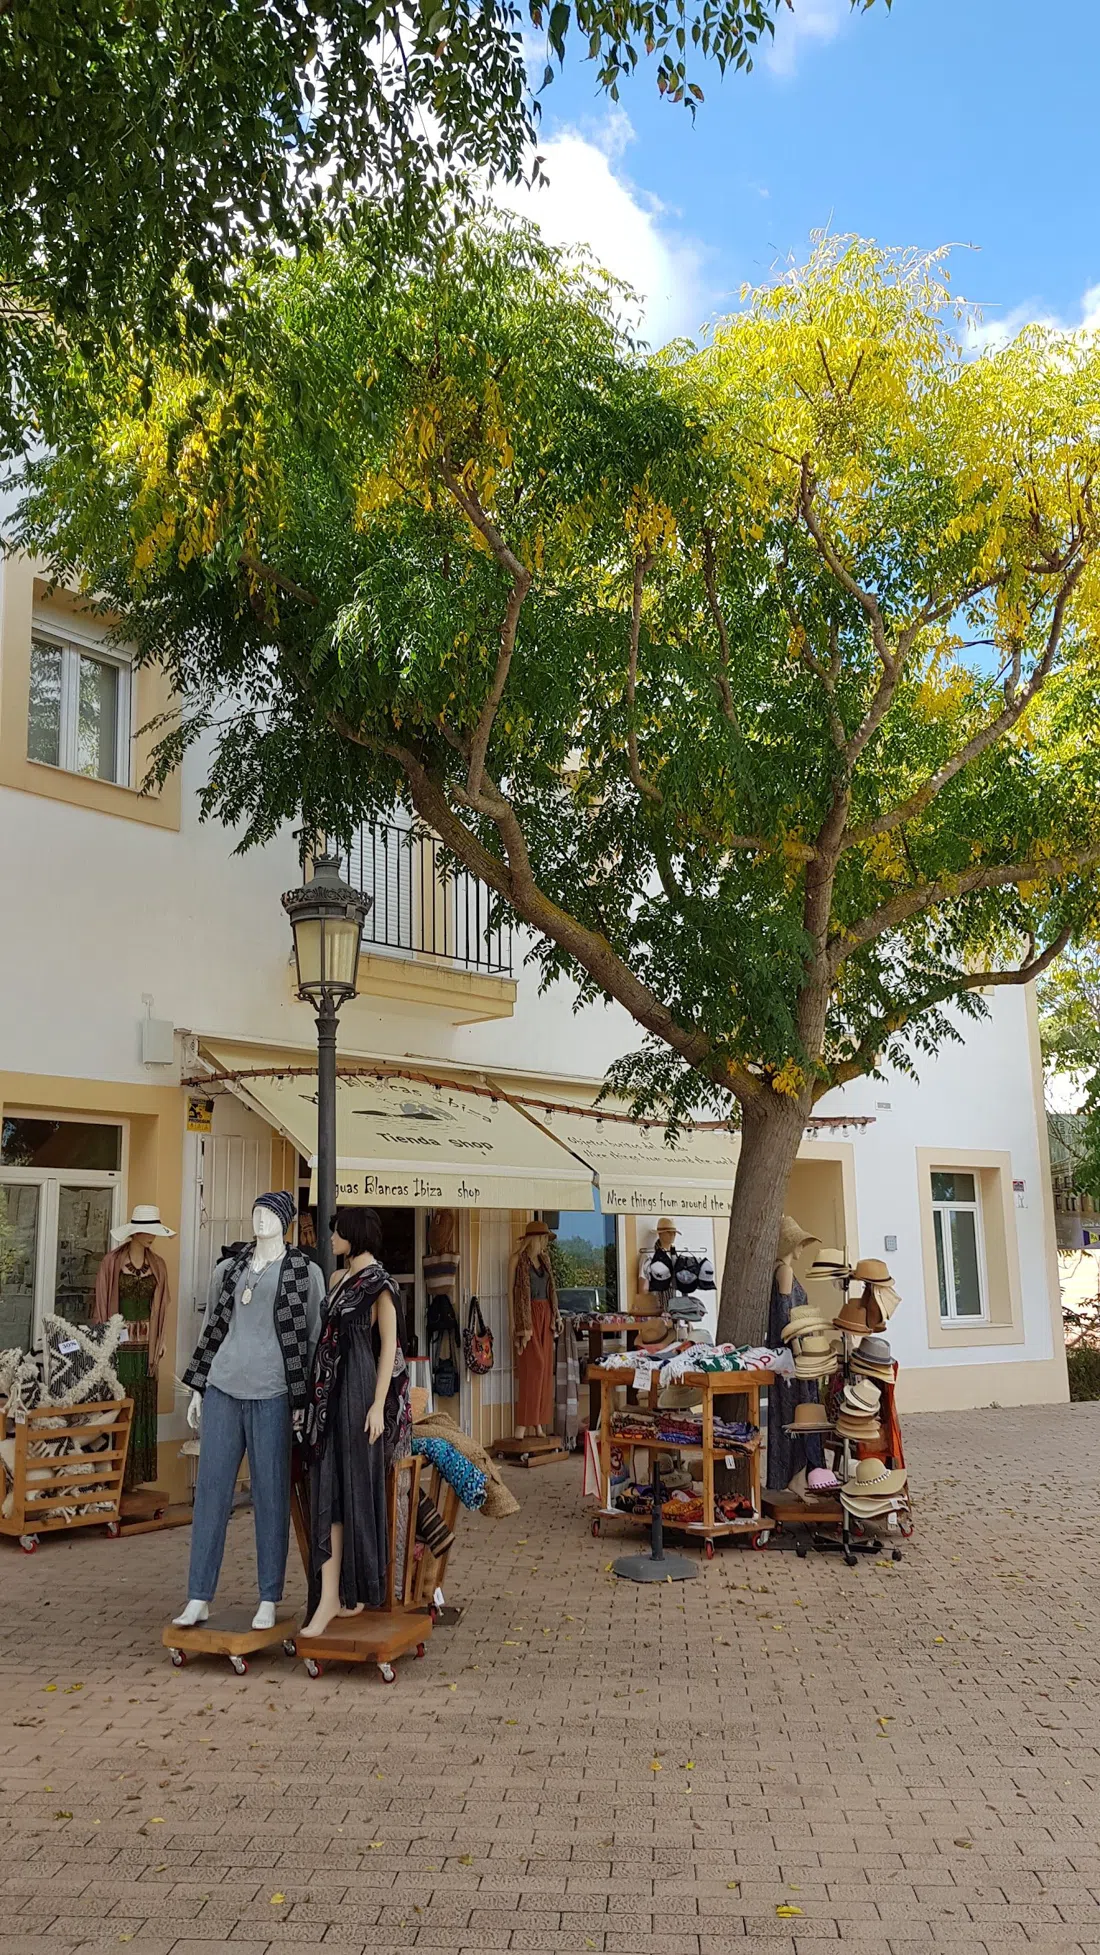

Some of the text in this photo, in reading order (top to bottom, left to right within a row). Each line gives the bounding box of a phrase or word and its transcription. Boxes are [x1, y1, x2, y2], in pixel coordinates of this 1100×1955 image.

[433, 1092, 492, 1123] biza
[378, 1132, 441, 1146] Tienda
[609, 1150, 641, 1163] things
[664, 1155, 695, 1164] around
[694, 1155, 713, 1164] the
[335, 1175, 481, 1203] guas Blancas Ibiza shop
[606, 1189, 628, 1207] Nice
[631, 1190, 657, 1212] things
[659, 1191, 679, 1211] from
[681, 1194, 708, 1210] around
[710, 1194, 725, 1210] the
[62, 1341, 77, 1349] 30%
